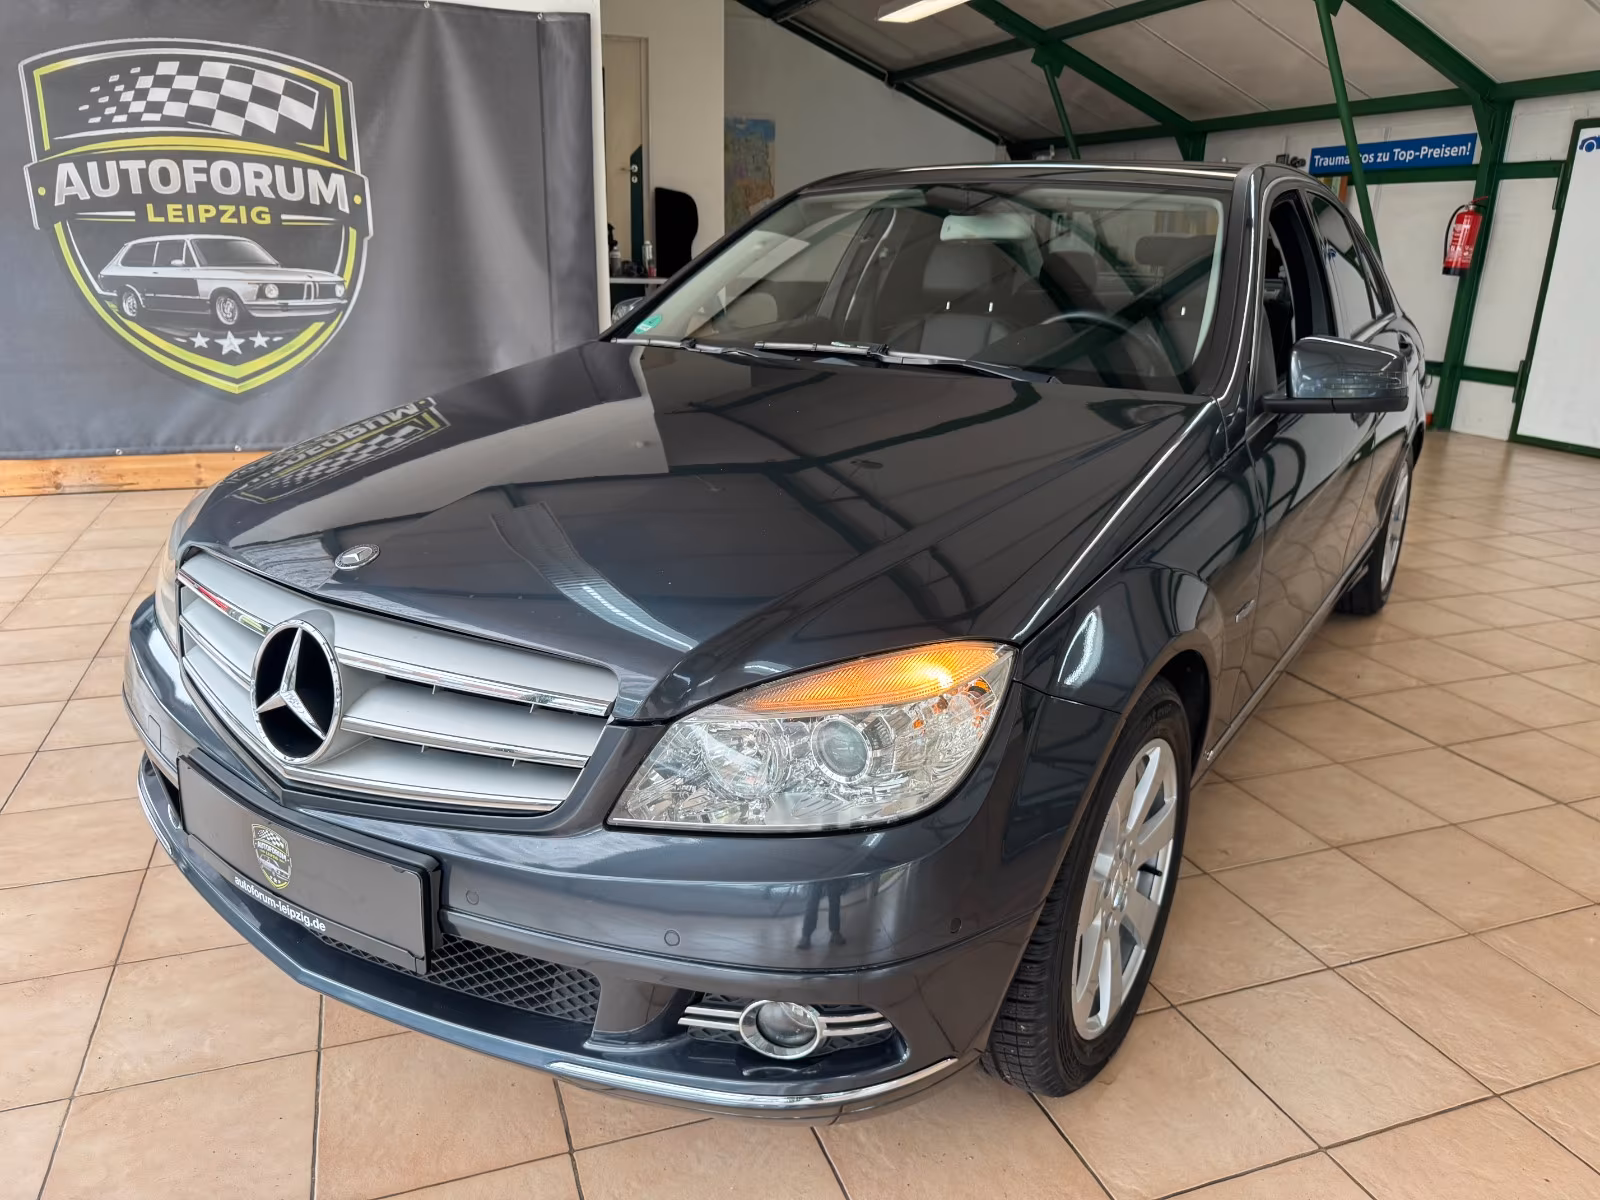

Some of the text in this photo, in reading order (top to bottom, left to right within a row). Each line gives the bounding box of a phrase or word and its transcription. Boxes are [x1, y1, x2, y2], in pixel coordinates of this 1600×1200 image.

[1314, 142, 1472, 167] Traumaos zu Top-Preisen!
[54, 159, 350, 214] AUTOFORUM
[146, 203, 272, 225] LEIPZIG
[235, 876, 326, 932] autoforum-leipzig.de
